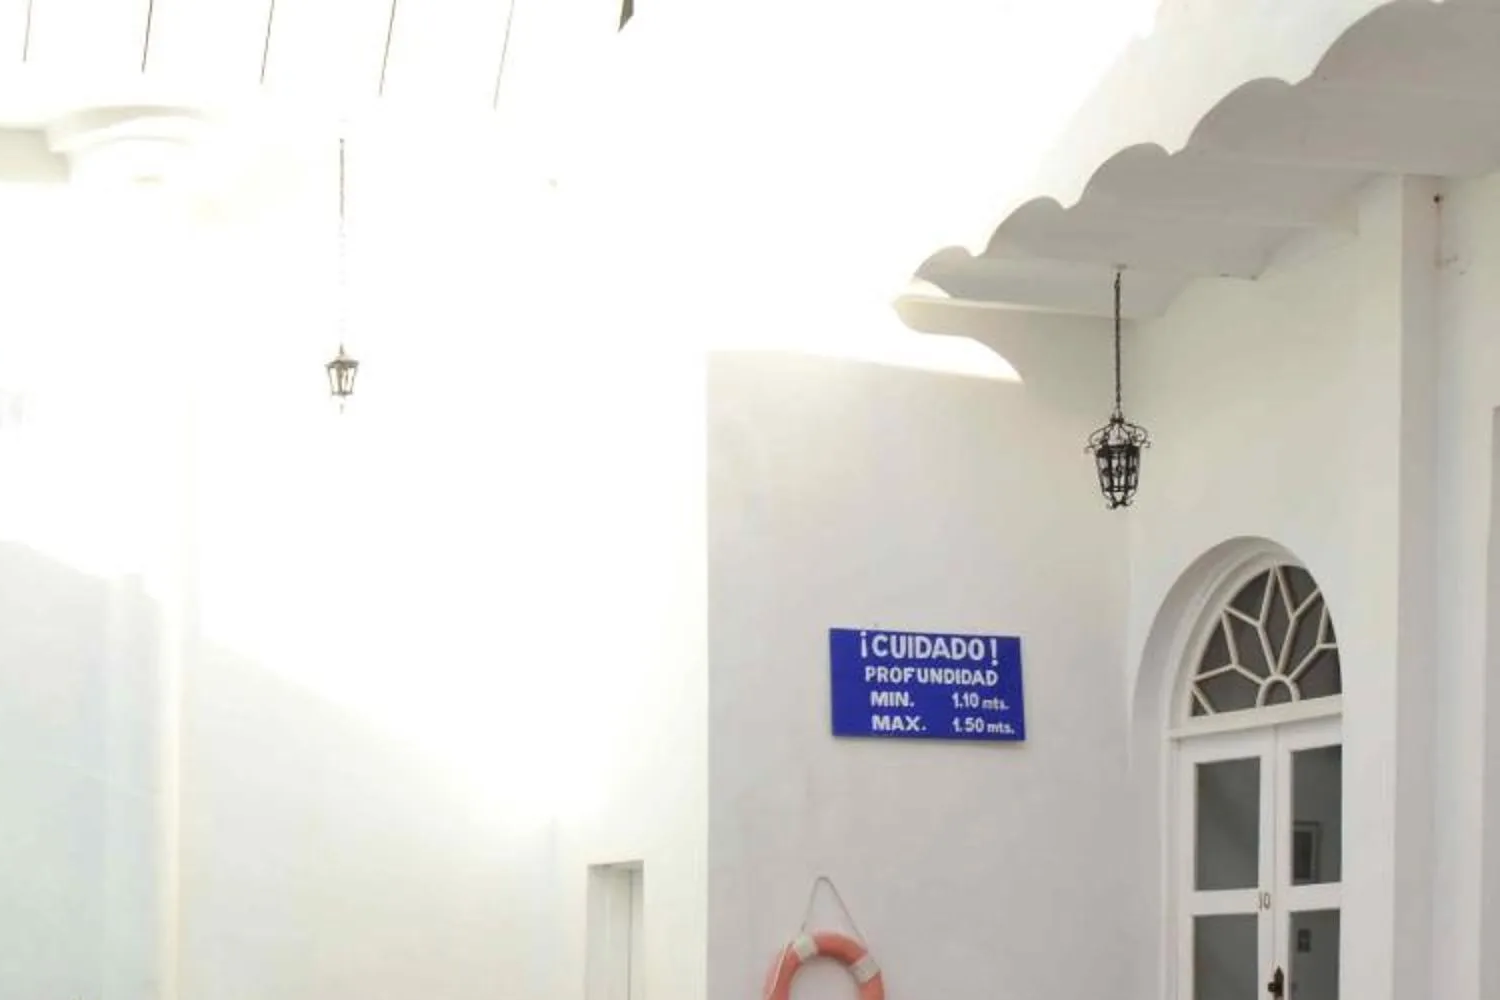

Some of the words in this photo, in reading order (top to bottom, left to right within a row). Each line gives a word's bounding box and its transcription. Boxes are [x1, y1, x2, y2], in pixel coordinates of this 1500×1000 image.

[860, 631, 998, 666] ¡CUIDADO!
[865, 666, 998, 686] PROFUNDIDAD
[870, 691, 915, 708] MIN.
[952, 692, 979, 709] 1.10
[982, 697, 1010, 711] mts.
[872, 714, 927, 732] MAX.
[953, 716, 985, 733] 1.50
[987, 721, 1015, 735] mts.
